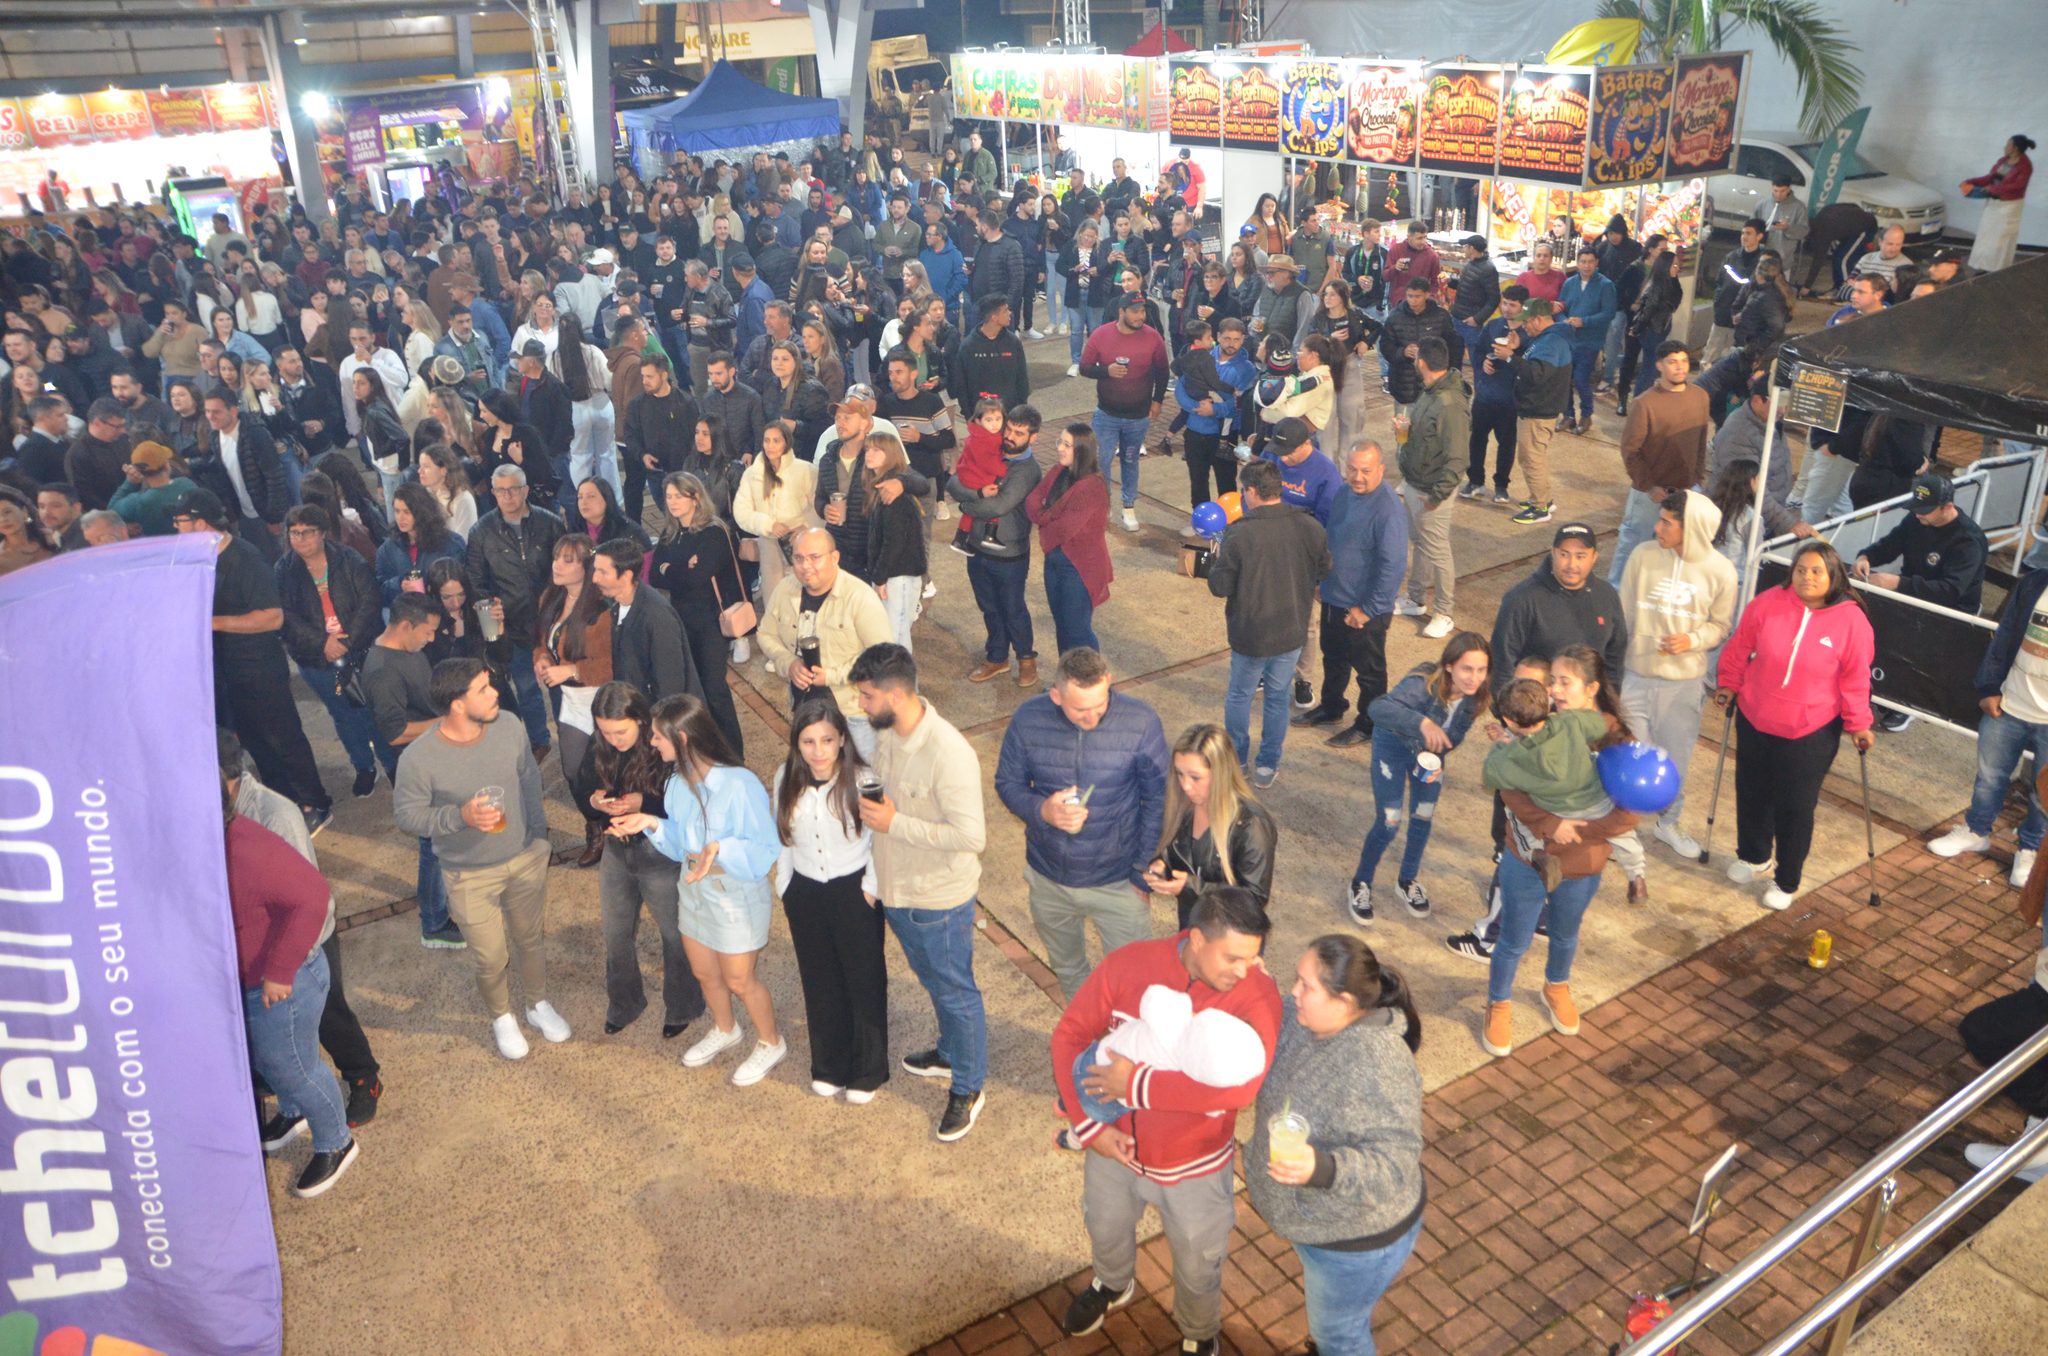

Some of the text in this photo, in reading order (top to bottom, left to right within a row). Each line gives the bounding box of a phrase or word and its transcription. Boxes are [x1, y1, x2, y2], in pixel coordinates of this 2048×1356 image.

[1288, 62, 1338, 82] Batata
[1600, 69, 1665, 98] Batata
[630, 85, 670, 95] UNSA
[1043, 68, 1123, 104] DRINKS
[1243, 83, 1277, 106] ESPETINHO
[1357, 82, 1408, 109] Morango
[1, 107, 13, 131] S
[1361, 106, 1398, 131] Chocolate
[1451, 97, 1497, 121] ESPETINHO
[1533, 98, 1586, 129] ESPETINHO
[35, 116, 77, 133] REI
[93, 111, 149, 129] CREPE
[1497, 180, 1537, 242] REPS
[74, 778, 172, 1269] conectada com o seu mundo.
